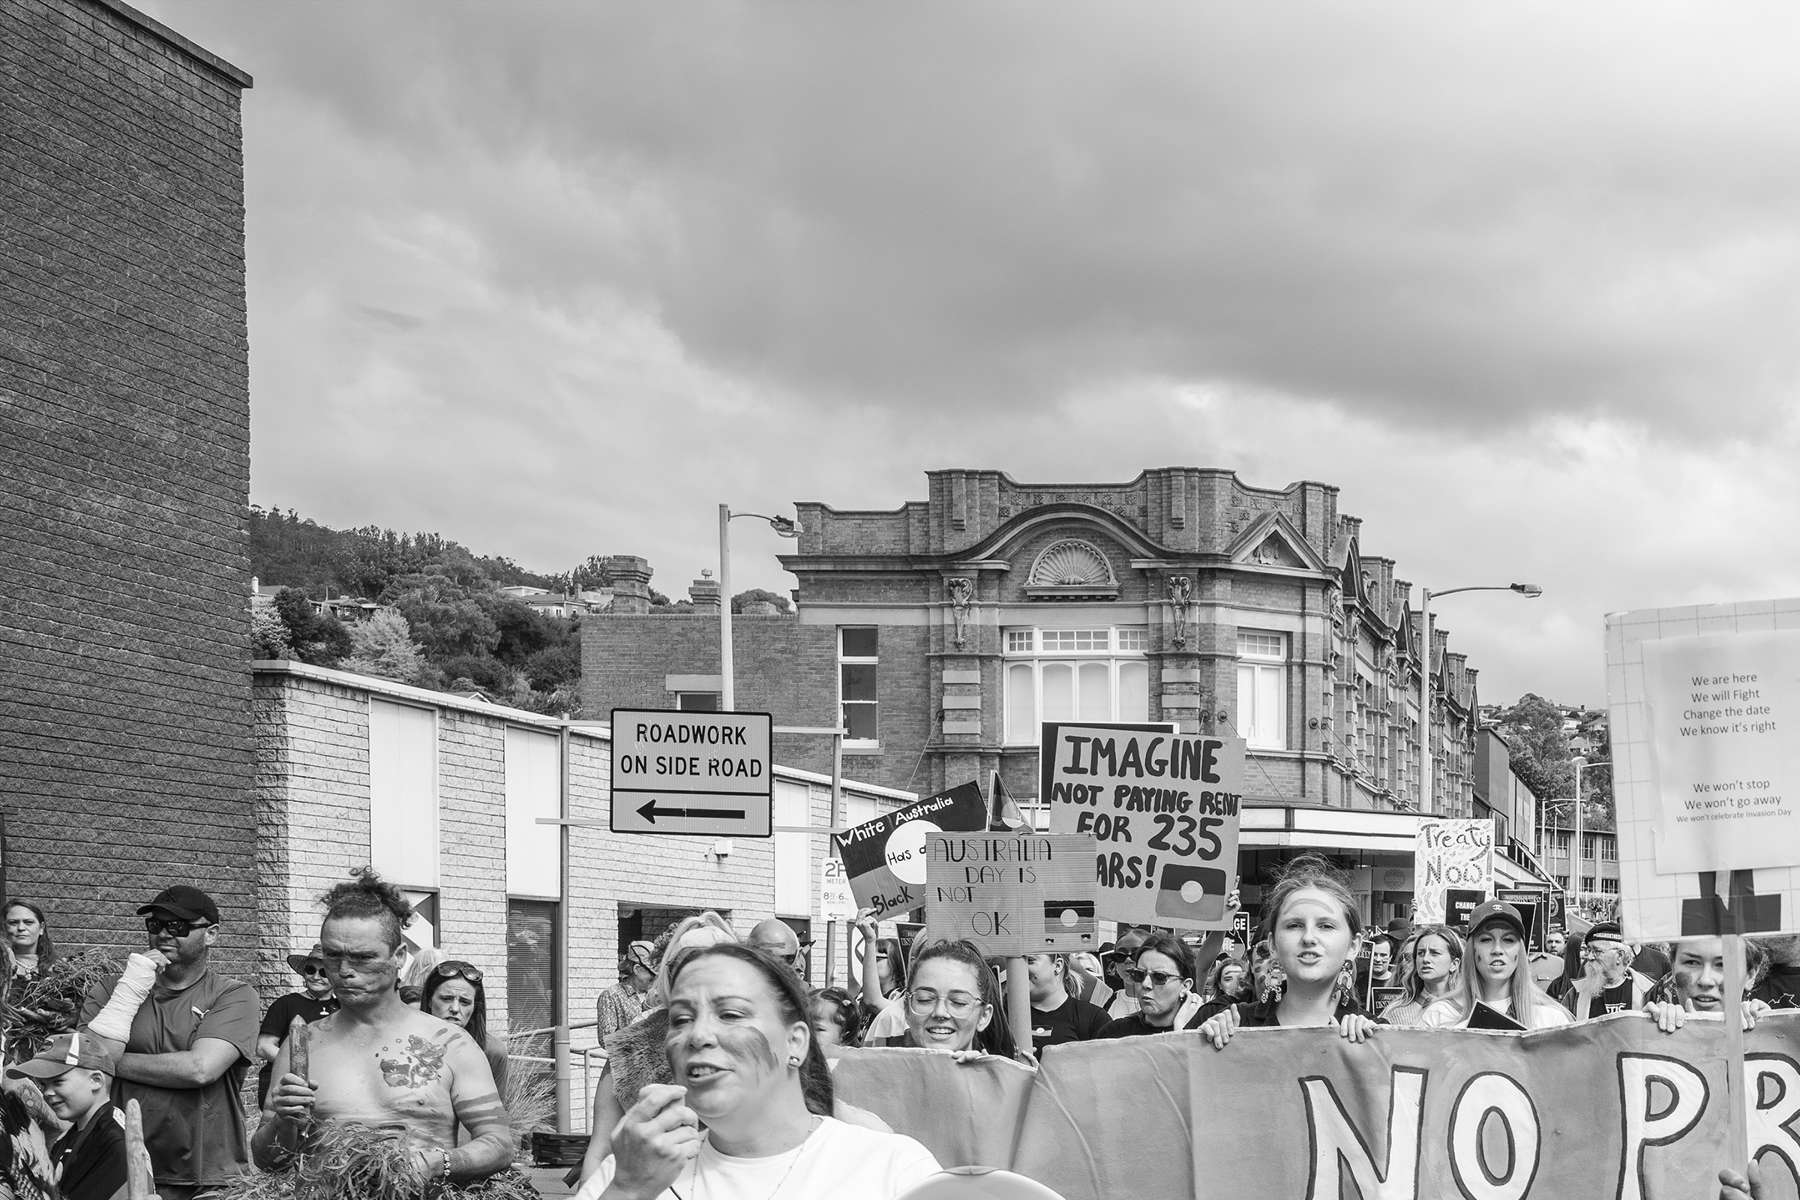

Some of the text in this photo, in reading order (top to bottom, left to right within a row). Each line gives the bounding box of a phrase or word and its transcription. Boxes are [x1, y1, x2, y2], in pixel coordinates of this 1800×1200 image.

[1692, 673, 1757, 686] We are here
[1692, 689, 1760, 702] We will Fight
[1683, 705, 1770, 721] Change the date
[636, 724, 746, 745] ROADWORK
[1680, 720, 1776, 736] We know it's right
[621, 755, 762, 777] ON SIDE ROAD
[1063, 735, 1223, 783] IMAGINE
[1693, 778, 1770, 792] We won't stop
[1052, 782, 1241, 817] NOT PAYING RENT
[1684, 794, 1782, 810] We won't go away
[837, 796, 953, 849] White Australia
[1077, 812, 1223, 861] FOR 235
[1421, 823, 1491, 861] Treaty
[887, 848, 911, 866] Has
[935, 839, 1051, 862] AUSTRALIA
[966, 866, 1036, 884] DAY IS
[1097, 854, 1157, 888] ARS!
[871, 886, 913, 915] Black
[938, 886, 974, 903] NOT
[972, 911, 1011, 937] OK
[1234, 918, 1246, 930] GE
